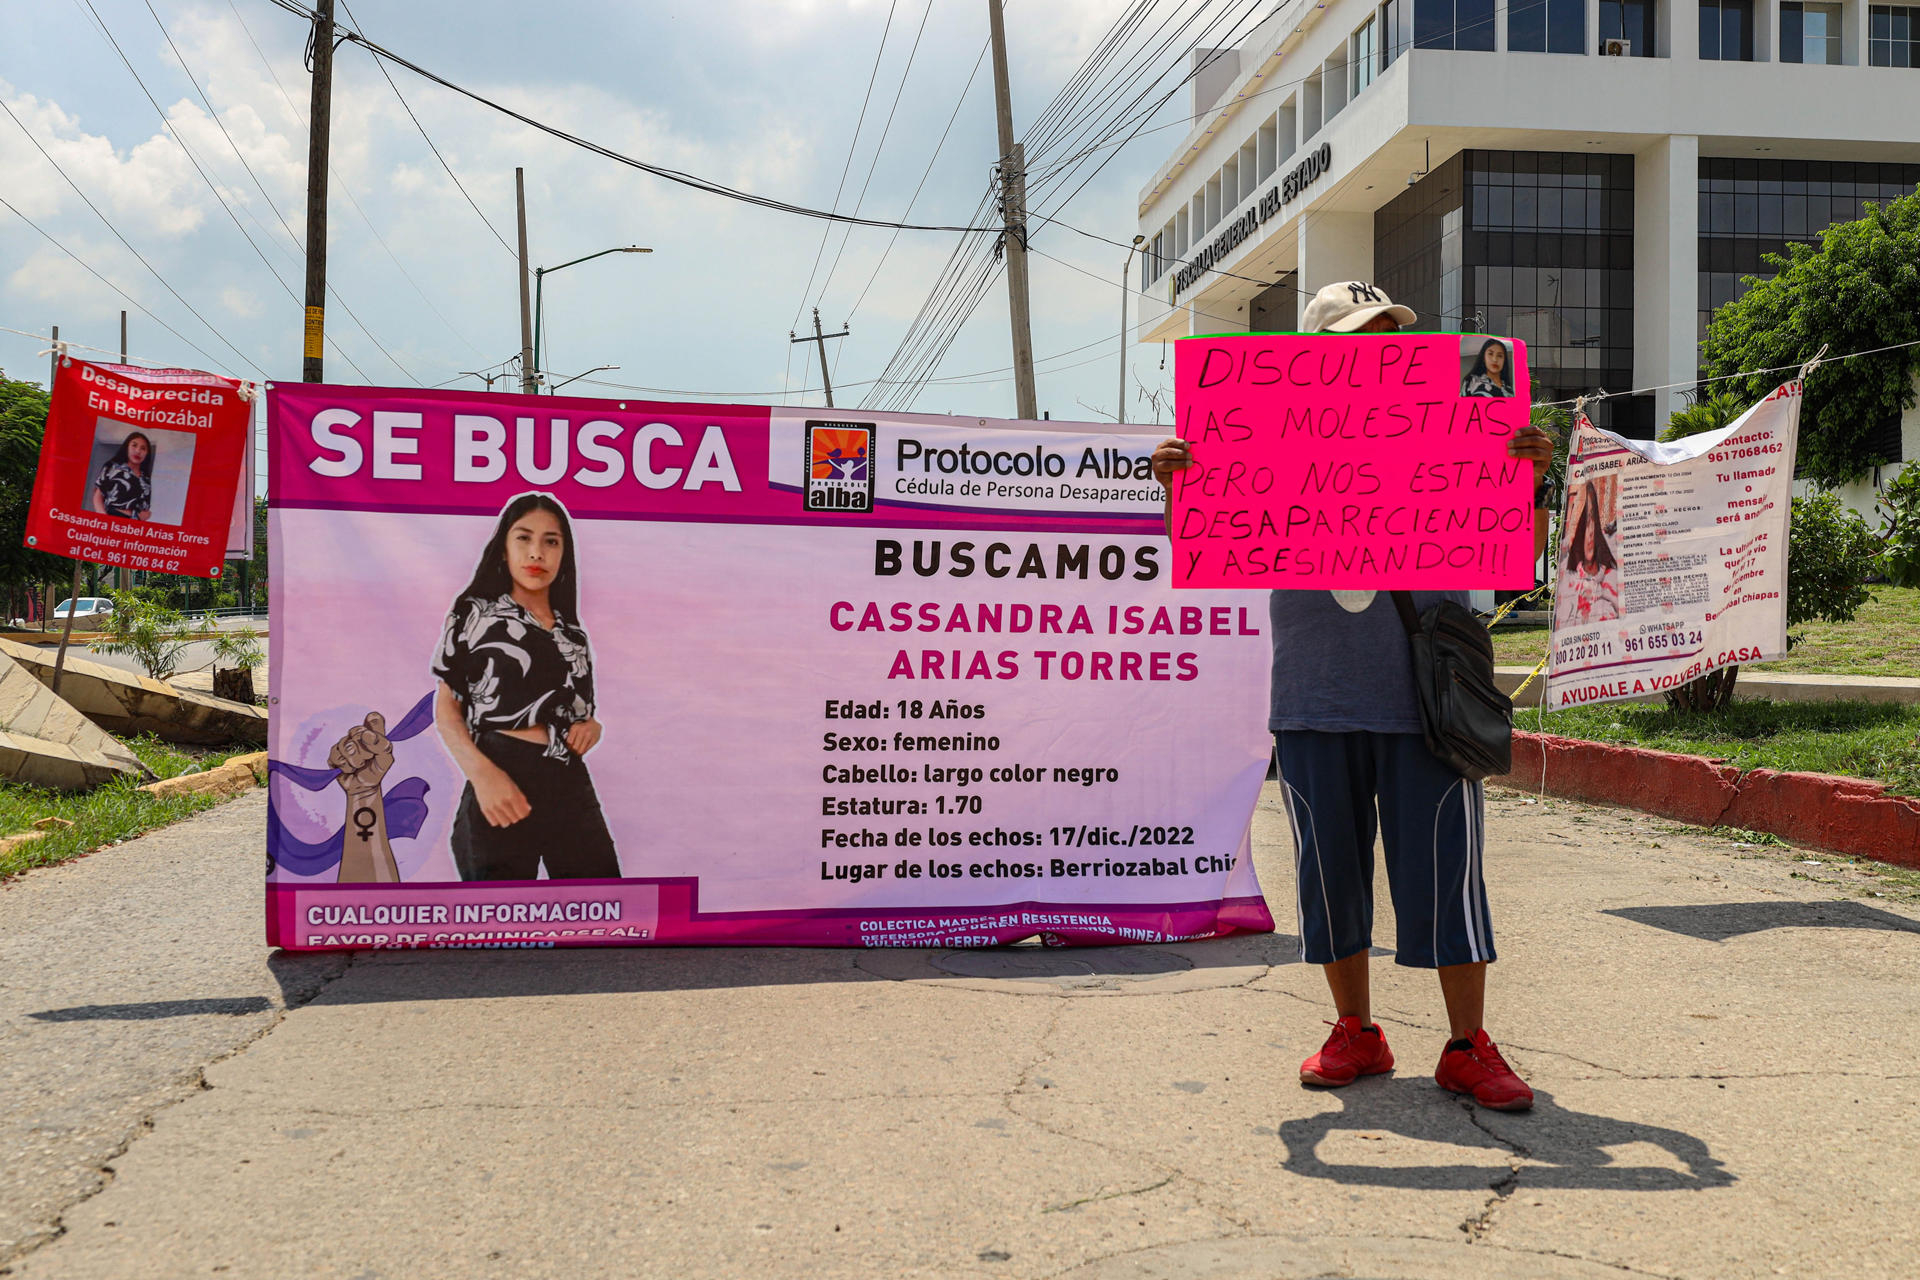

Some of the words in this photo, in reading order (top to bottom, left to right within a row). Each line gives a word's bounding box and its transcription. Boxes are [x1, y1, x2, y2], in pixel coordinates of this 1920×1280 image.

[1213, 206, 1258, 262] GENERAL
[1258, 185, 1281, 225] DEL
[1281, 142, 1332, 205] ESTADO
[1347, 282, 1381, 304] NY
[1198, 344, 1429, 388] DISCULPE
[81, 365, 224, 406] Desaparecida
[88, 390, 109, 412] En
[114, 400, 213, 428] Berriozábal
[1182, 404, 1253, 445] LAS
[1281, 400, 1512, 440] MOLESTIAS
[308, 407, 423, 481] SE
[453, 413, 743, 492] BUSCA
[896, 438, 1065, 478] Protocolo
[1075, 447, 1153, 480] Alba
[1707, 442, 1783, 463] 9617068462
[895, 478, 954, 496] Cédula
[960, 481, 981, 497] de
[987, 482, 1054, 500] Persona
[1178, 460, 1275, 502] PERO
[1300, 461, 1381, 495] NOS
[1409, 457, 1521, 493] ESTAN
[1716, 473, 1730, 483] Tu
[1745, 485, 1752, 493] o
[810, 487, 866, 509] alba
[49, 507, 108, 531] Cassandra
[110, 520, 144, 537] Isabel
[145, 527, 174, 541] Arias
[177, 531, 210, 545] Torres
[1179, 502, 1532, 540] DESAPARECIENDO!
[1716, 512, 1741, 525] será
[66, 528, 121, 548] Cualquier
[123, 538, 188, 558] información
[1720, 547, 1733, 556] La
[69, 545, 80, 555] al
[82, 546, 103, 561] Cel.
[107, 552, 127, 564] 961
[130, 555, 149, 568] 706
[150, 557, 164, 570] 84
[166, 560, 180, 571] 62
[874, 539, 1160, 581] BUSCAMOS
[1186, 550, 1202, 581] Y
[1222, 541, 1509, 577] ASESINANDO!!!
[1742, 590, 1779, 604] Chiapas
[829, 601, 1094, 634] CASSANDRA
[1107, 605, 1261, 636] ISABEL
[1647, 621, 1685, 633] WHATSAPP
[1569, 648, 1574, 662] 2
[1575, 646, 1586, 660] 20
[1588, 644, 1599, 658] 20
[1601, 641, 1612, 656] 11
[1625, 637, 1644, 652] 961
[1648, 635, 1668, 650] 655
[1671, 633, 1686, 647] 03
[1689, 630, 1703, 644] 24
[887, 649, 1020, 680] ARIAS
[1034, 650, 1199, 681] TORRES
[1561, 680, 1628, 706] AYUDALE
[1633, 679, 1645, 694] A
[1649, 662, 1701, 691] VOLVER
[1705, 657, 1714, 671] A
[1718, 646, 1762, 666] CASA
[824, 699, 889, 719] Edad:
[896, 700, 924, 719] 18
[928, 699, 985, 720] Años
[822, 733, 887, 752] Sexo:
[893, 731, 1000, 751] femenino
[822, 764, 918, 784] Cabello:
[924, 764, 982, 786] largo
[989, 764, 1047, 783] color
[1053, 767, 1119, 788] negro
[821, 796, 928, 816] Estatura:
[935, 796, 983, 815] 1.70
[820, 828, 888, 848] Fecha
[894, 827, 922, 847] de
[928, 827, 962, 847] los
[968, 827, 1043, 847] echos:
[1049, 825, 1195, 848] 17/dic./2022
[820, 861, 888, 884] Lugar
[894, 860, 923, 879] de
[928, 860, 962, 879] los
[968, 859, 1044, 879] echos:
[1050, 857, 1188, 878] Berriozabal
[307, 904, 448, 926] CUALQUIER
[454, 901, 621, 923] INFORMACION
[859, 919, 936, 932] COLECTICA
[1000, 914, 1018, 925] EN
[1021, 912, 1112, 926] RESISTENCIA
